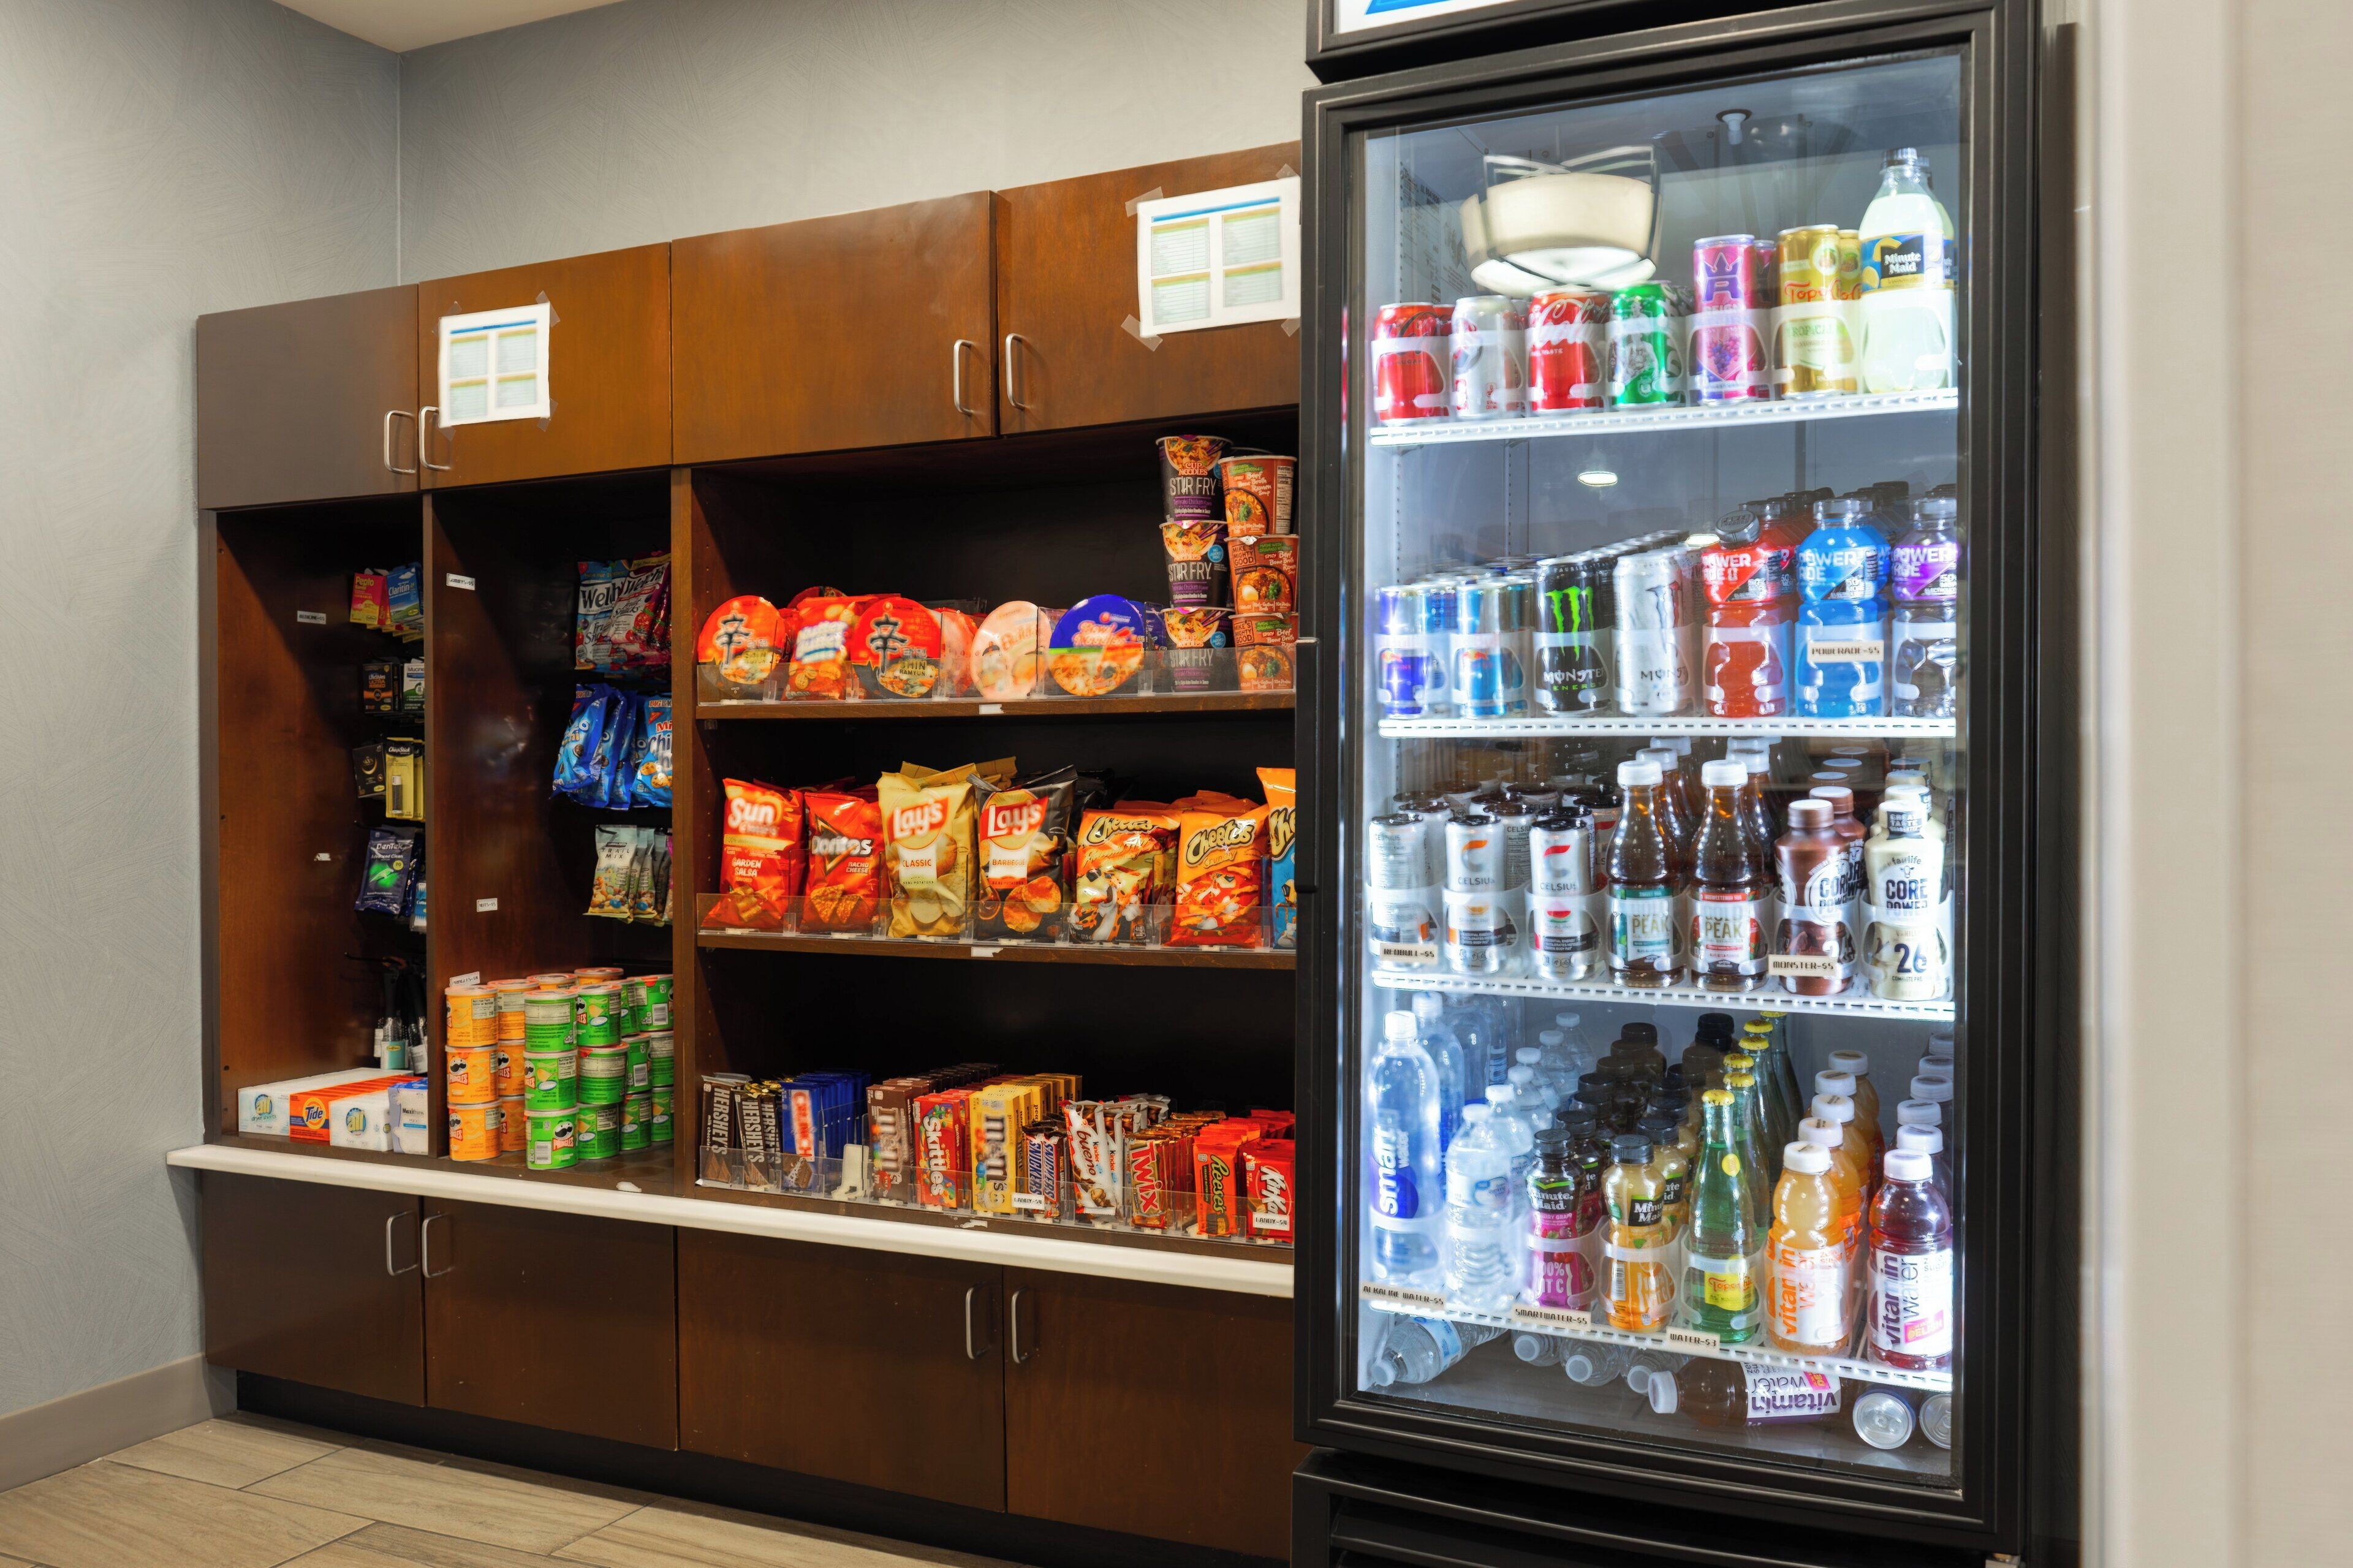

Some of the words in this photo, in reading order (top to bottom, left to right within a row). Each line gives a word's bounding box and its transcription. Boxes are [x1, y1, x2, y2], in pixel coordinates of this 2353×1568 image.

[1884, 251, 1922, 265] Minute
[1888, 262, 1917, 275] Maid
[1246, 471, 1263, 480] Beef
[1169, 476, 1194, 496] STIR
[1232, 544, 1253, 553] MIKE'S
[1893, 547, 1958, 563] POWER
[1234, 556, 1254, 566] GOOD
[1168, 562, 1188, 582] STIR
[355, 576, 374, 587] Pepto
[388, 583, 410, 596] Claritin
[900, 660, 928, 670] SHIN
[656, 721, 672, 732] Mi
[648, 734, 672, 751] Chi
[727, 797, 775, 829] Sun
[892, 798, 944, 839] Lay's
[987, 799, 1042, 839] Lay's
[811, 835, 874, 857] Doritos
[1186, 818, 1256, 866] Cheetos
[731, 857, 763, 869] GARDEN
[901, 858, 933, 868] CLASSIC
[1892, 855, 1922, 865] fairlife
[734, 867, 758, 877] SALSA
[1458, 876, 1495, 885] CELSIUS
[1540, 882, 1579, 892] CELSIUS
[1885, 877, 1928, 900] CORE
[1632, 917, 1670, 934] PEAK
[1705, 921, 1743, 939] PEAK
[1894, 943, 1927, 973] 26
[254, 1096, 271, 1116] all
[305, 1105, 324, 1122] Tide
[346, 1110, 365, 1132] all
[711, 1087, 731, 1156] HERSHEY'S
[741, 1100, 765, 1164] HERSHEY'S
[553, 1138, 574, 1151] PRINGLES
[1076, 1130, 1097, 1176] bueno
[923, 1115, 947, 1196] Skittles
[1029, 1140, 1042, 1195] SNICKERS
[1043, 1140, 1055, 1200] SNICKERS
[1373, 1124, 1398, 1216] smart
[1634, 1202, 1662, 1213] Minu
[1540, 1261, 1564, 1276] 00%
[1363, 1285, 1400, 1299] ALKALINE
[1751, 1392, 1837, 1414] vitamin
